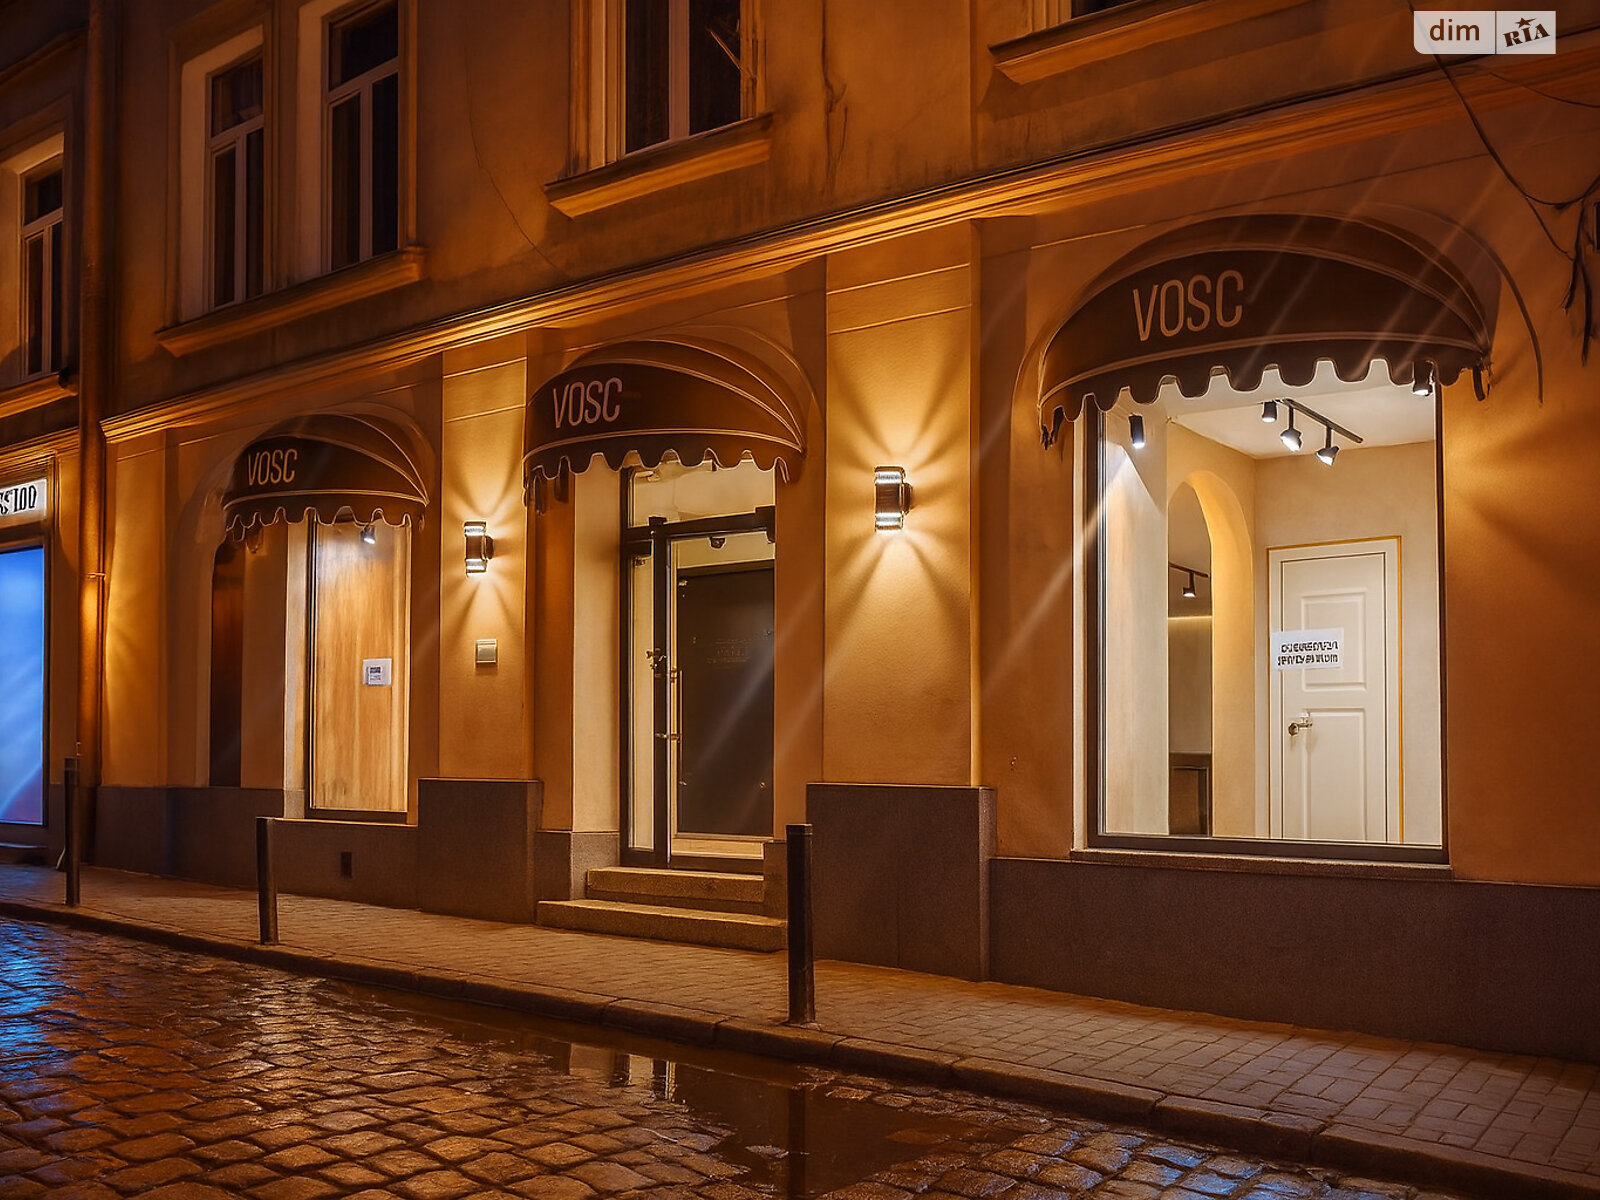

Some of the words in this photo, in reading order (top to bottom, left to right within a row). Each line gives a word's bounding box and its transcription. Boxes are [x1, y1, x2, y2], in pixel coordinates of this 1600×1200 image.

[1132, 269, 1244, 342] VOSC
[552, 376, 623, 429] VOSC
[247, 448, 298, 486] VOSC
